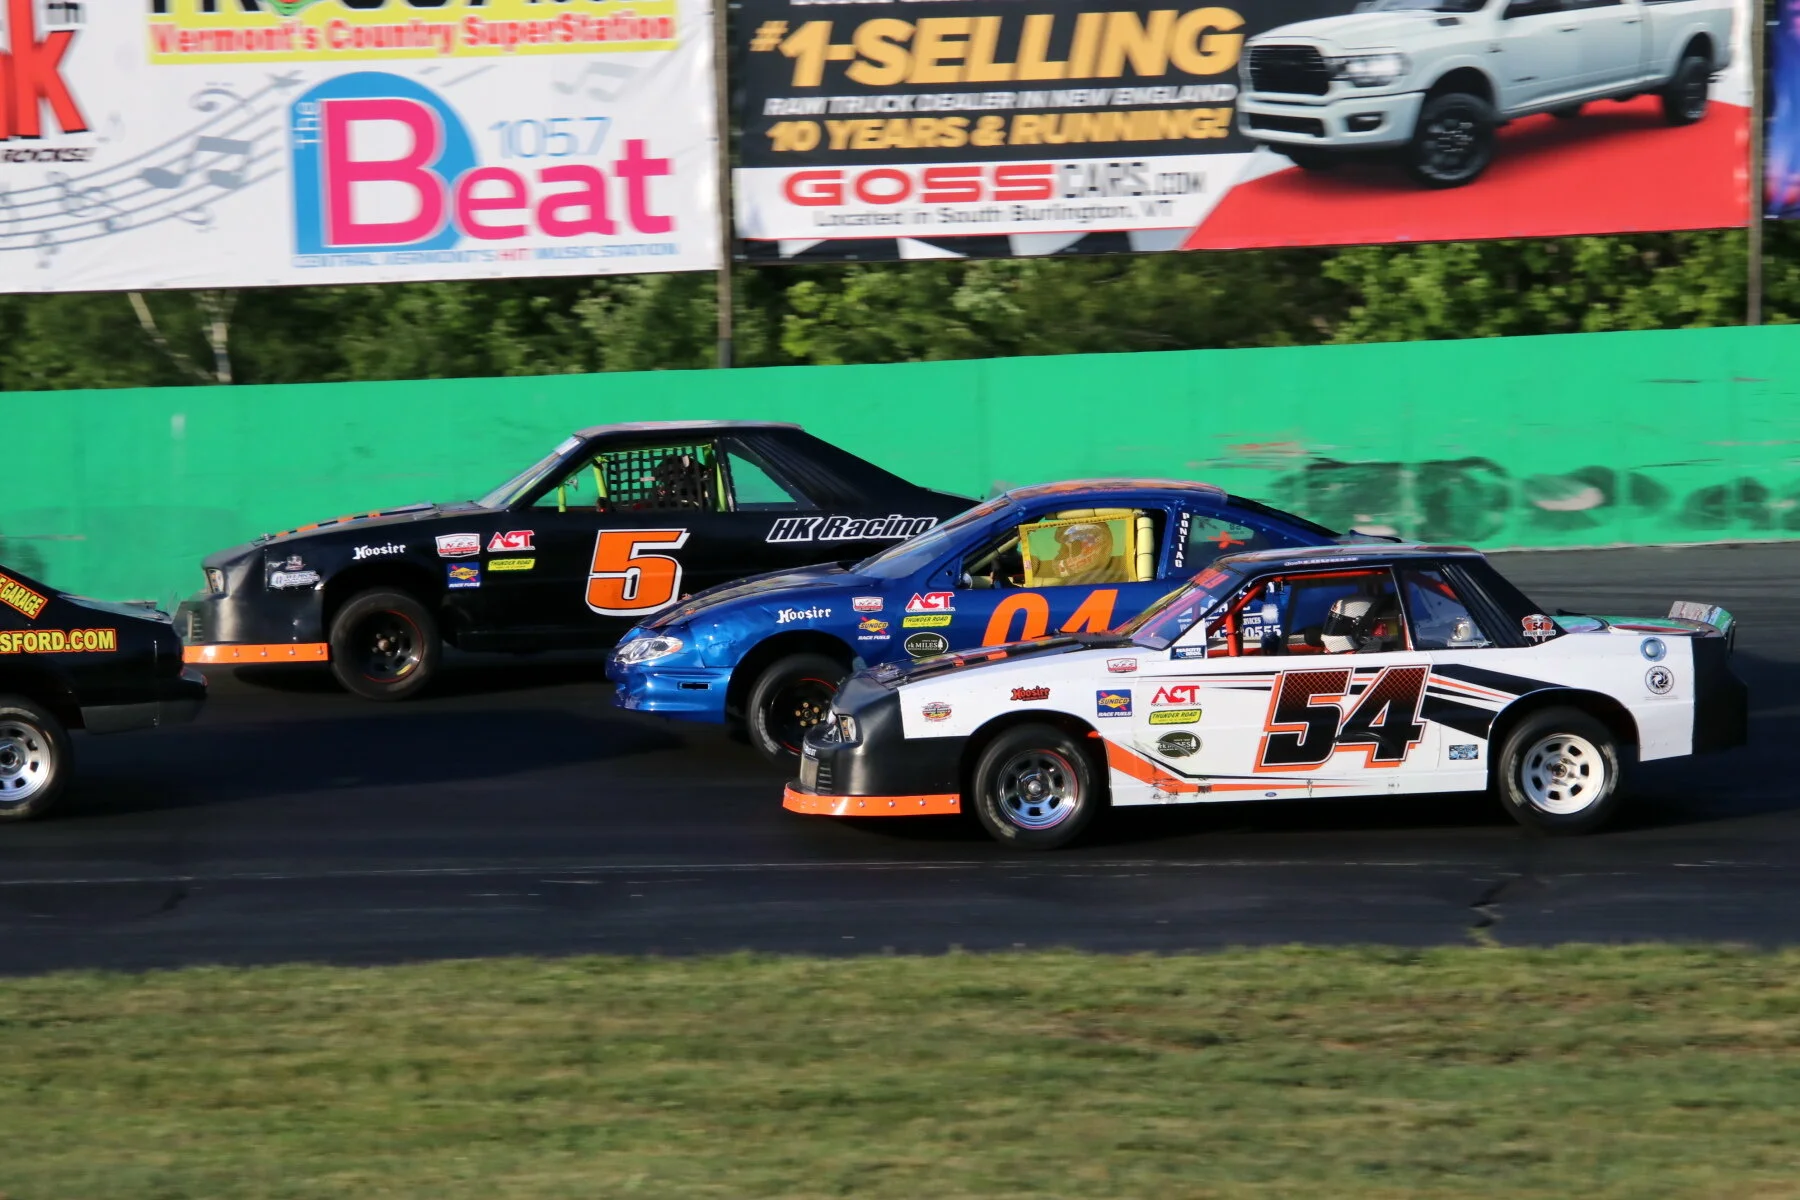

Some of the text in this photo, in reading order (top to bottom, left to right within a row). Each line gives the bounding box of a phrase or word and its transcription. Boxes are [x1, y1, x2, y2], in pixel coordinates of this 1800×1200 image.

[151, 11, 675, 54] Vermont's Country SuperStation
[749, 7, 1246, 87] #1-SELLING
[828, 94, 914, 114] TRUCK
[914, 92, 1016, 112] DEALER
[1017, 91, 1043, 109] IN
[1046, 88, 1110, 108] NEW
[1111, 84, 1239, 105] ENGLAND
[766, 107, 1234, 151] 10 YEARS & RUNNING!
[321, 98, 677, 246] Beat
[813, 209, 903, 226] Located
[910, 208, 930, 224] in
[937, 205, 999, 223] South
[1141, 200, 1174, 217] VT
[498, 247, 531, 262] HIT
[487, 530, 535, 550] ACT
[765, 513, 939, 544] HK Racing
[1174, 512, 1190, 568] PONTIAC
[352, 542, 406, 560] Hoosier
[585, 528, 691, 616] 5
[0, 582, 43, 616] GARAGE
[776, 605, 831, 623] Hoosier
[906, 592, 954, 609] ACT
[0, 631, 114, 652] SFORD.COM
[1010, 685, 1050, 701] Hoosier
[1151, 685, 1200, 704] ACT
[1252, 664, 1433, 773] 54
